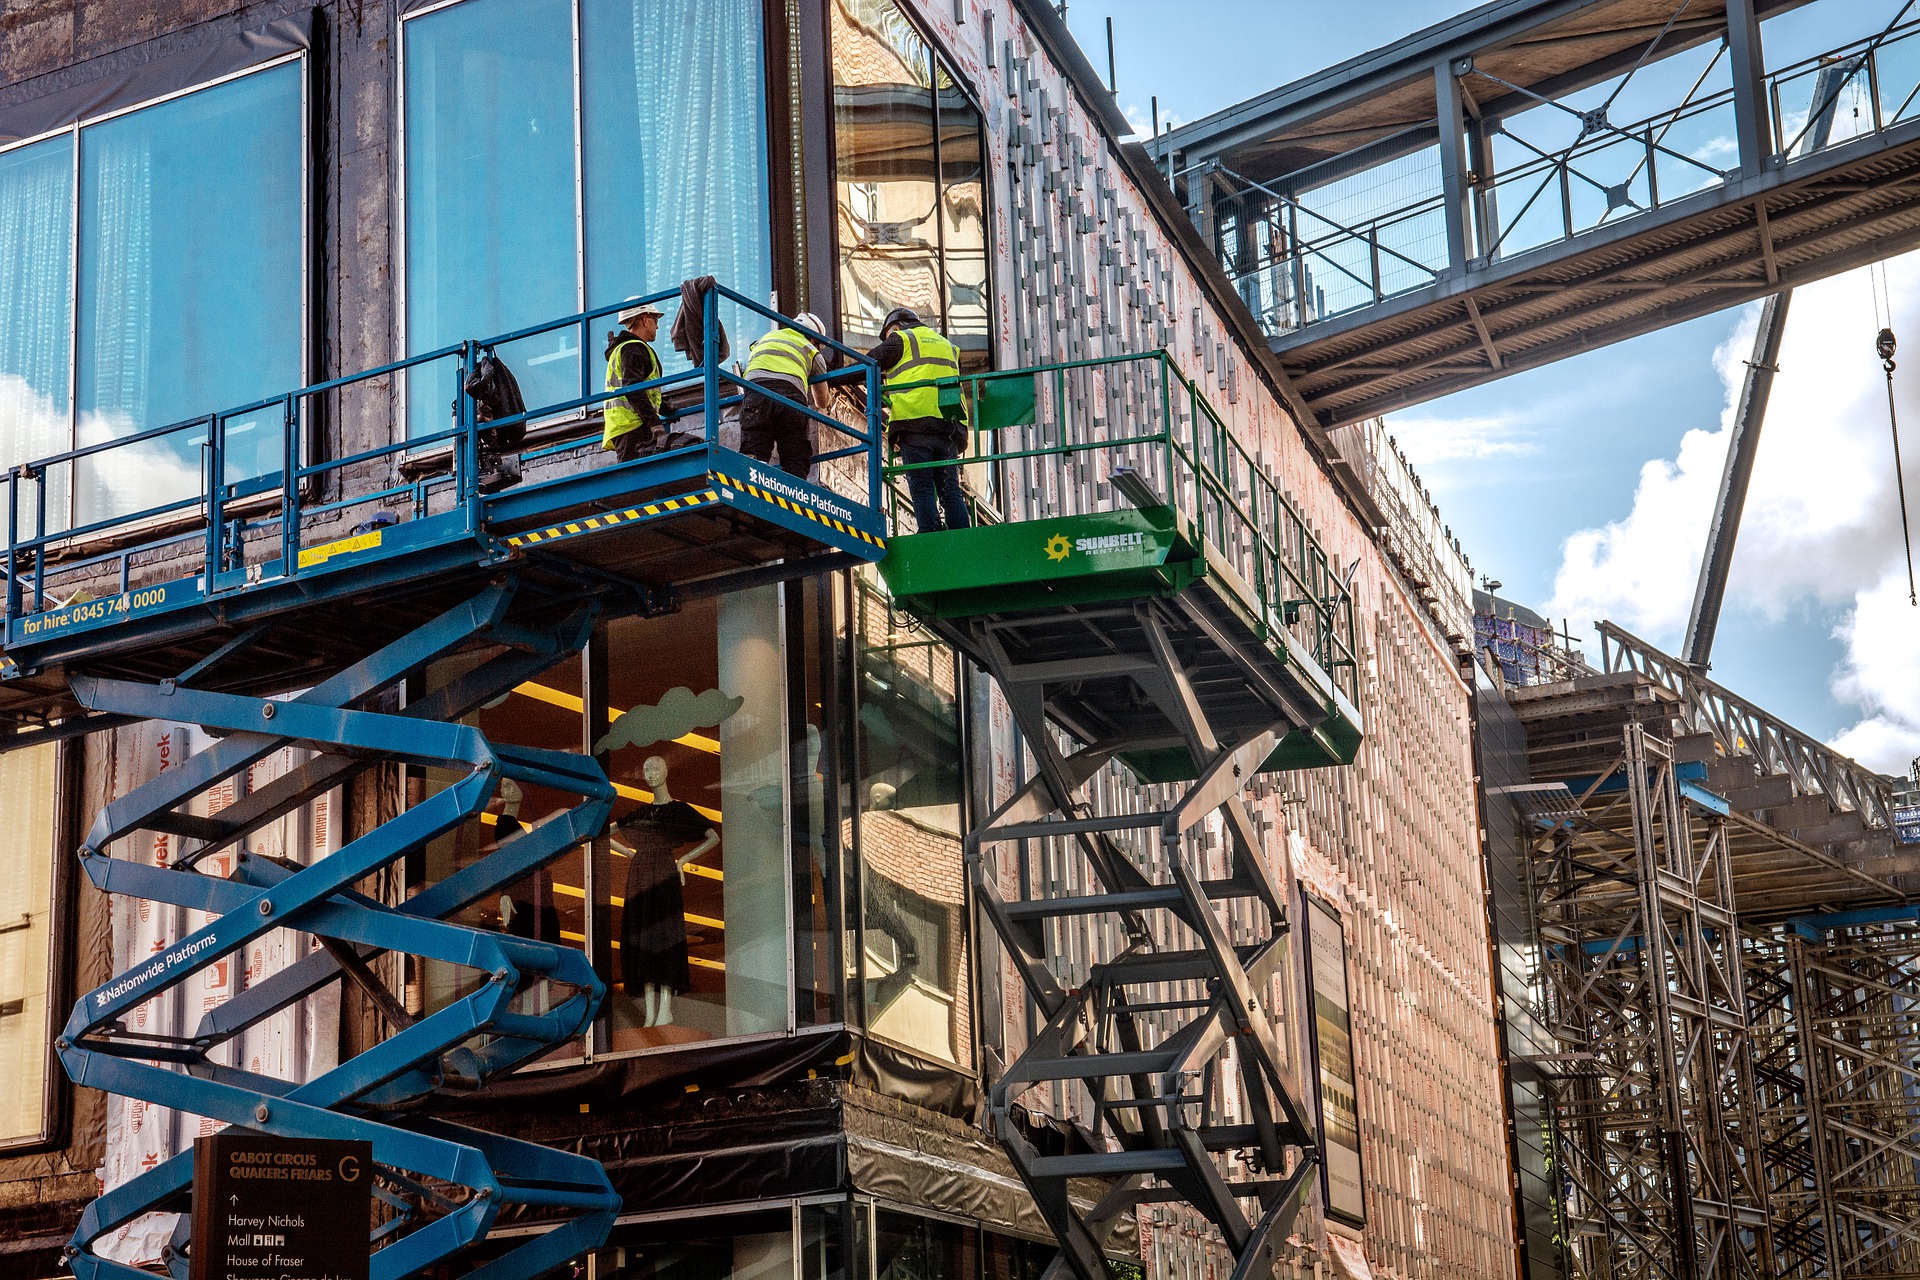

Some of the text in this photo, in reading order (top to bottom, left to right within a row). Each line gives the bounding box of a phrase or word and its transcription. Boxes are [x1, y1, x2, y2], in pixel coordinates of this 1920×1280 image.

[757, 472, 809, 504] Nationwide
[810, 493, 852, 521] Platforms
[1076, 532, 1144, 551] SUNBELT
[1086, 546, 1134, 556] RENTALS
[24, 588, 166, 635] for hire: 0345 74 0000
[106, 962, 165, 1001] Nationwide
[165, 933, 217, 968] Platforms
[230, 1151, 317, 1166] CABOT CIRCUS
[229, 1166, 332, 1181] QUAKERS FRIARS
[338, 1155, 360, 1182] G
[228, 1214, 305, 1229] Harvey Nichols
[227, 1233, 251, 1246] Mall
[227, 1253, 304, 1267] House of Fraser
